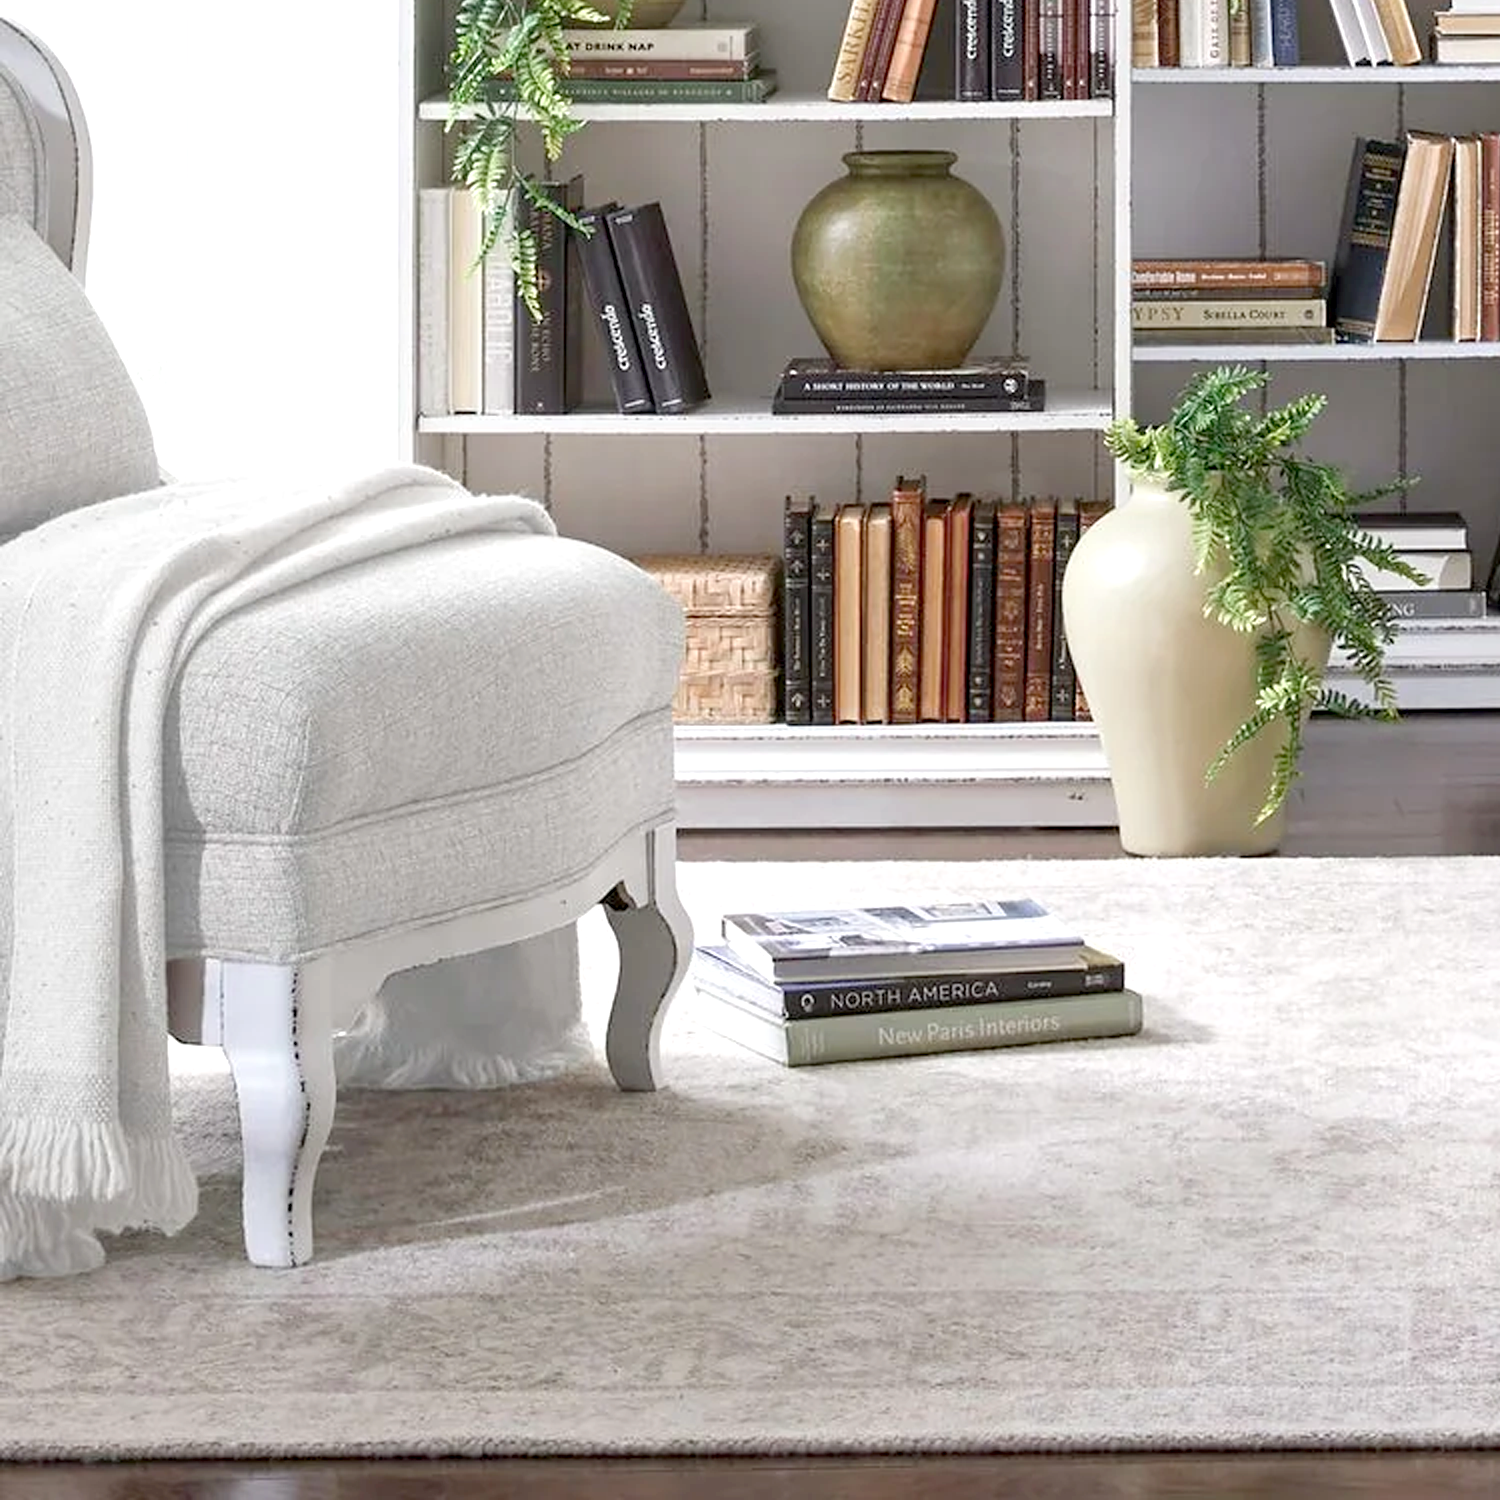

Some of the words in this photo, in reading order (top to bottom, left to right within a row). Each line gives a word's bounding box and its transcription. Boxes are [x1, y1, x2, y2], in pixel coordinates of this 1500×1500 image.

[586, 43, 625, 51] DRINK
[629, 43, 655, 51] NAP
[1209, 26, 1220, 58] GATE
[1203, 309, 1247, 320] SIBELLA
[1249, 309, 1287, 320] COURT
[602, 305, 630, 371] crescendo
[638, 303, 667, 370] crescendo
[804, 381, 811, 391] A
[813, 381, 842, 391] SHORT
[845, 381, 884, 391] HISTORY
[887, 381, 900, 391] OF
[902, 381, 918, 391] THE
[920, 381, 956, 391] WORLD
[831, 989, 902, 1010] NORTH
[908, 982, 999, 1004] AMERICA
[878, 1025, 922, 1046] New
[927, 1023, 975, 1042] Paris
[979, 1014, 1061, 1038] Interiors
